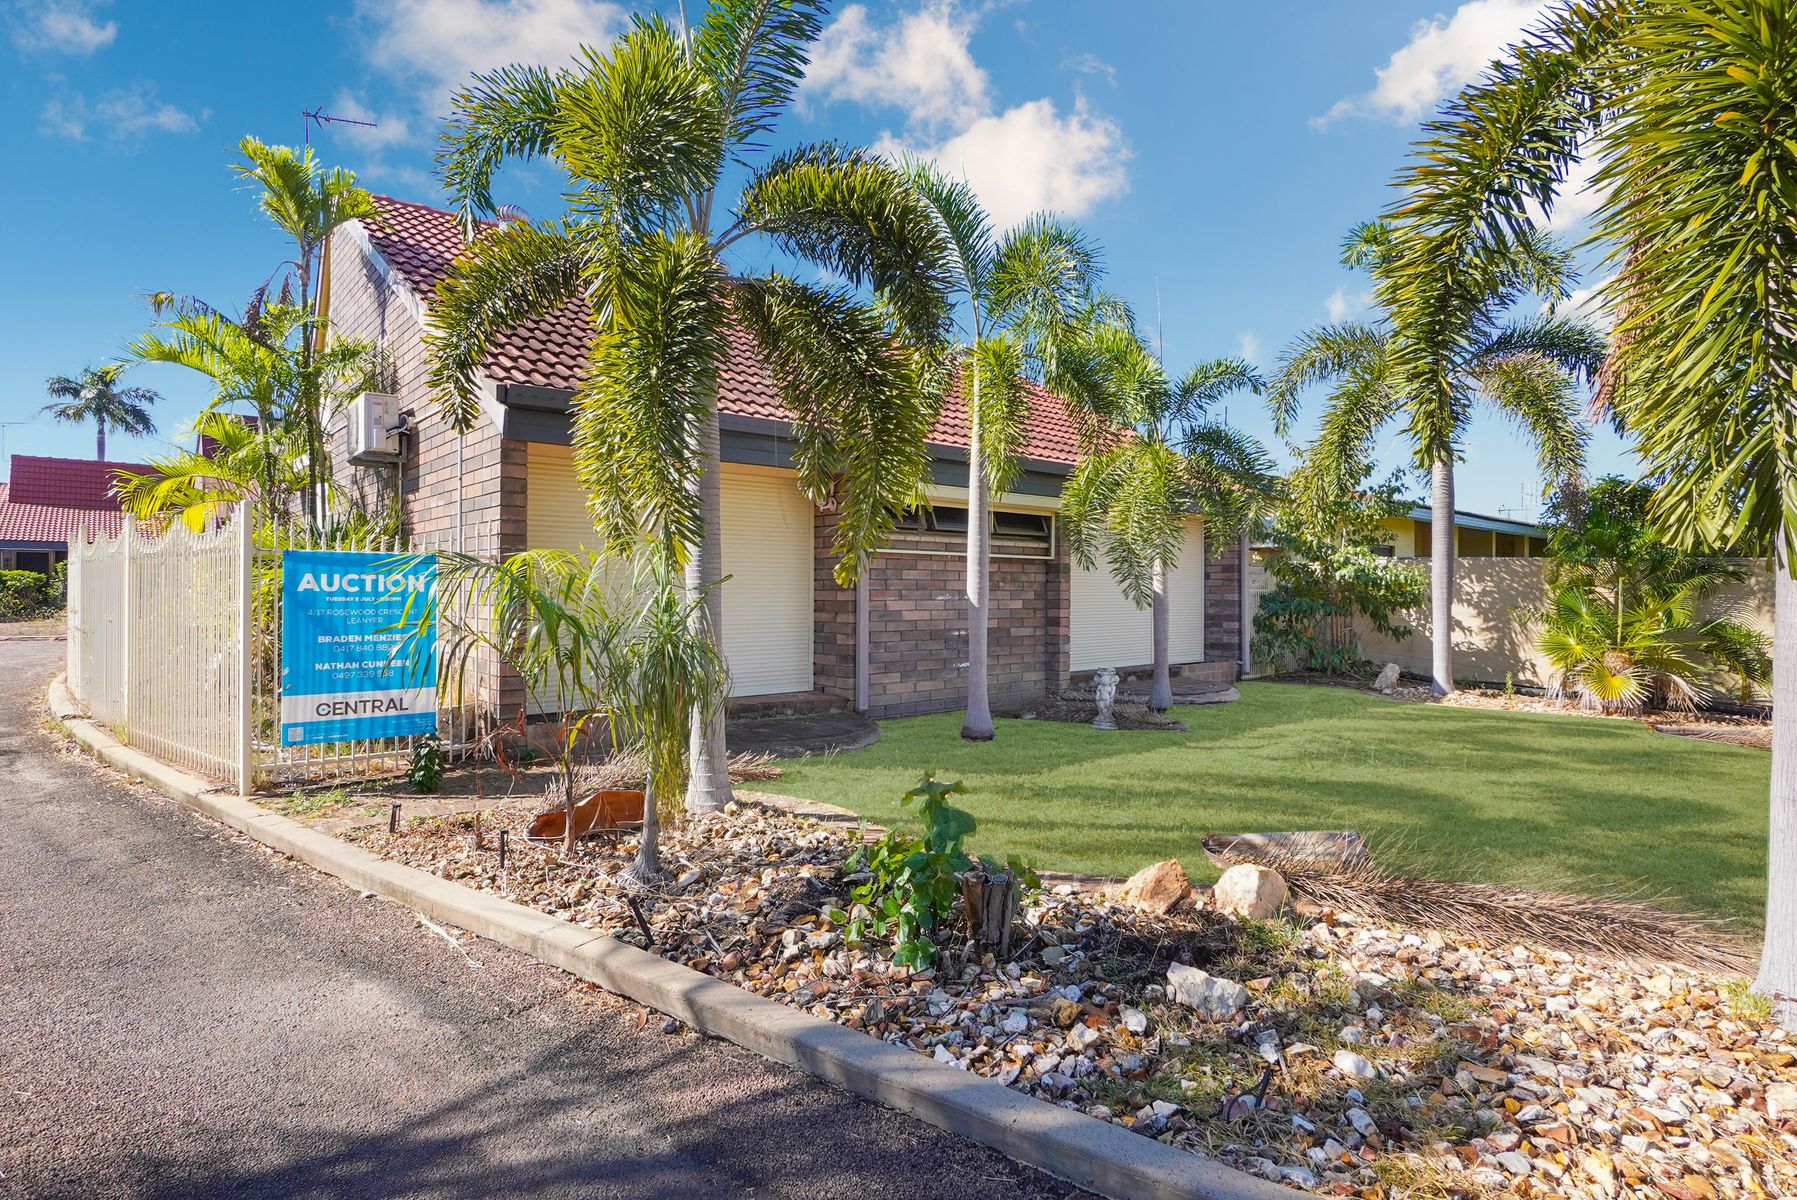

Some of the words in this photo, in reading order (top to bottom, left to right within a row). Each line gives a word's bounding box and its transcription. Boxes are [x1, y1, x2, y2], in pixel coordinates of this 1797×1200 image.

[297, 573, 425, 593] AUCTION
[327, 608, 376, 616] ROSEWOOD
[346, 617, 384, 625] LEANYER
[318, 634, 362, 643] BRADEN
[333, 645, 354, 653] 0417
[356, 644, 374, 652] 840
[315, 662, 359, 670] NATHAN
[316, 697, 409, 717] CENTRAL
